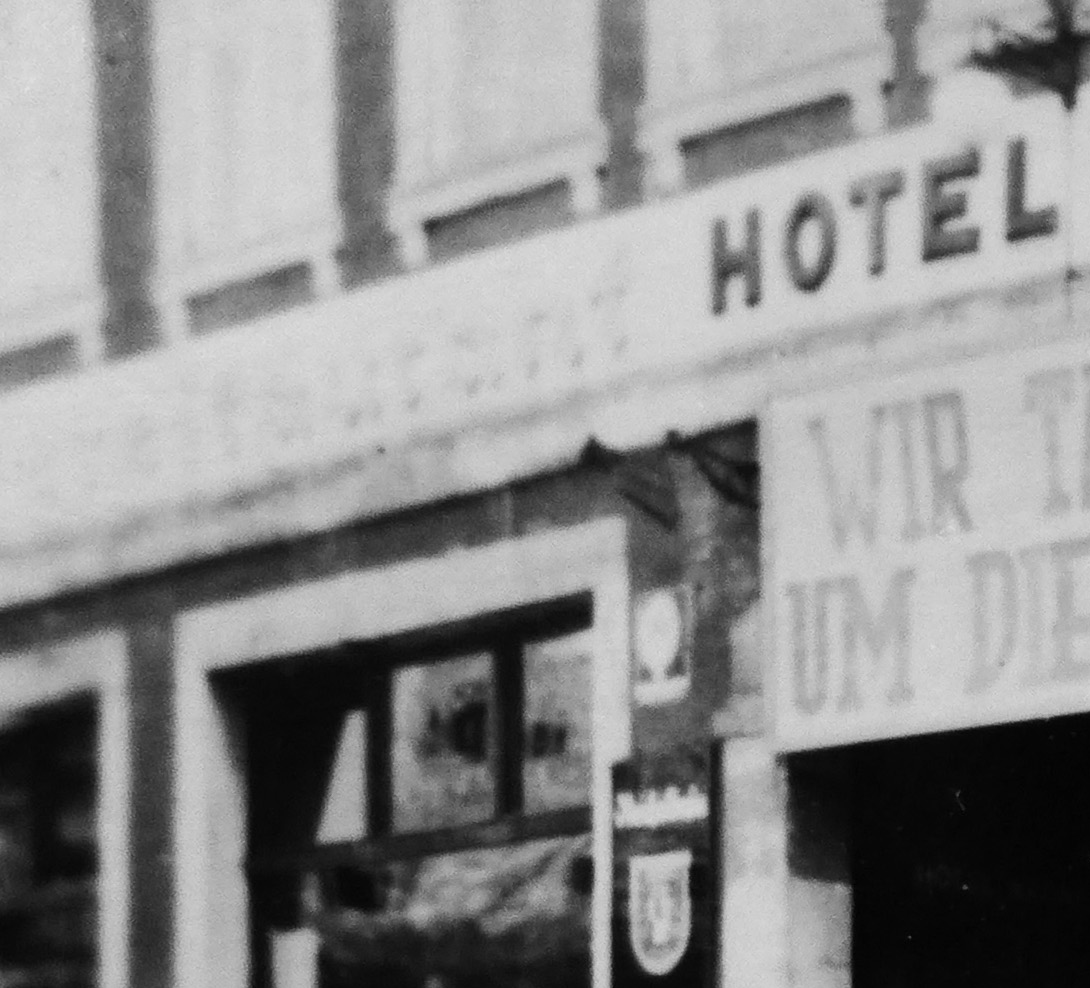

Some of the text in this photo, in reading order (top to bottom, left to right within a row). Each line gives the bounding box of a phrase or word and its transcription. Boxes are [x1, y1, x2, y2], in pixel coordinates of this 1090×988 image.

[711, 137, 1058, 314] HOTEL
[806, 390, 973, 550] WIR
[785, 567, 915, 717] UM
